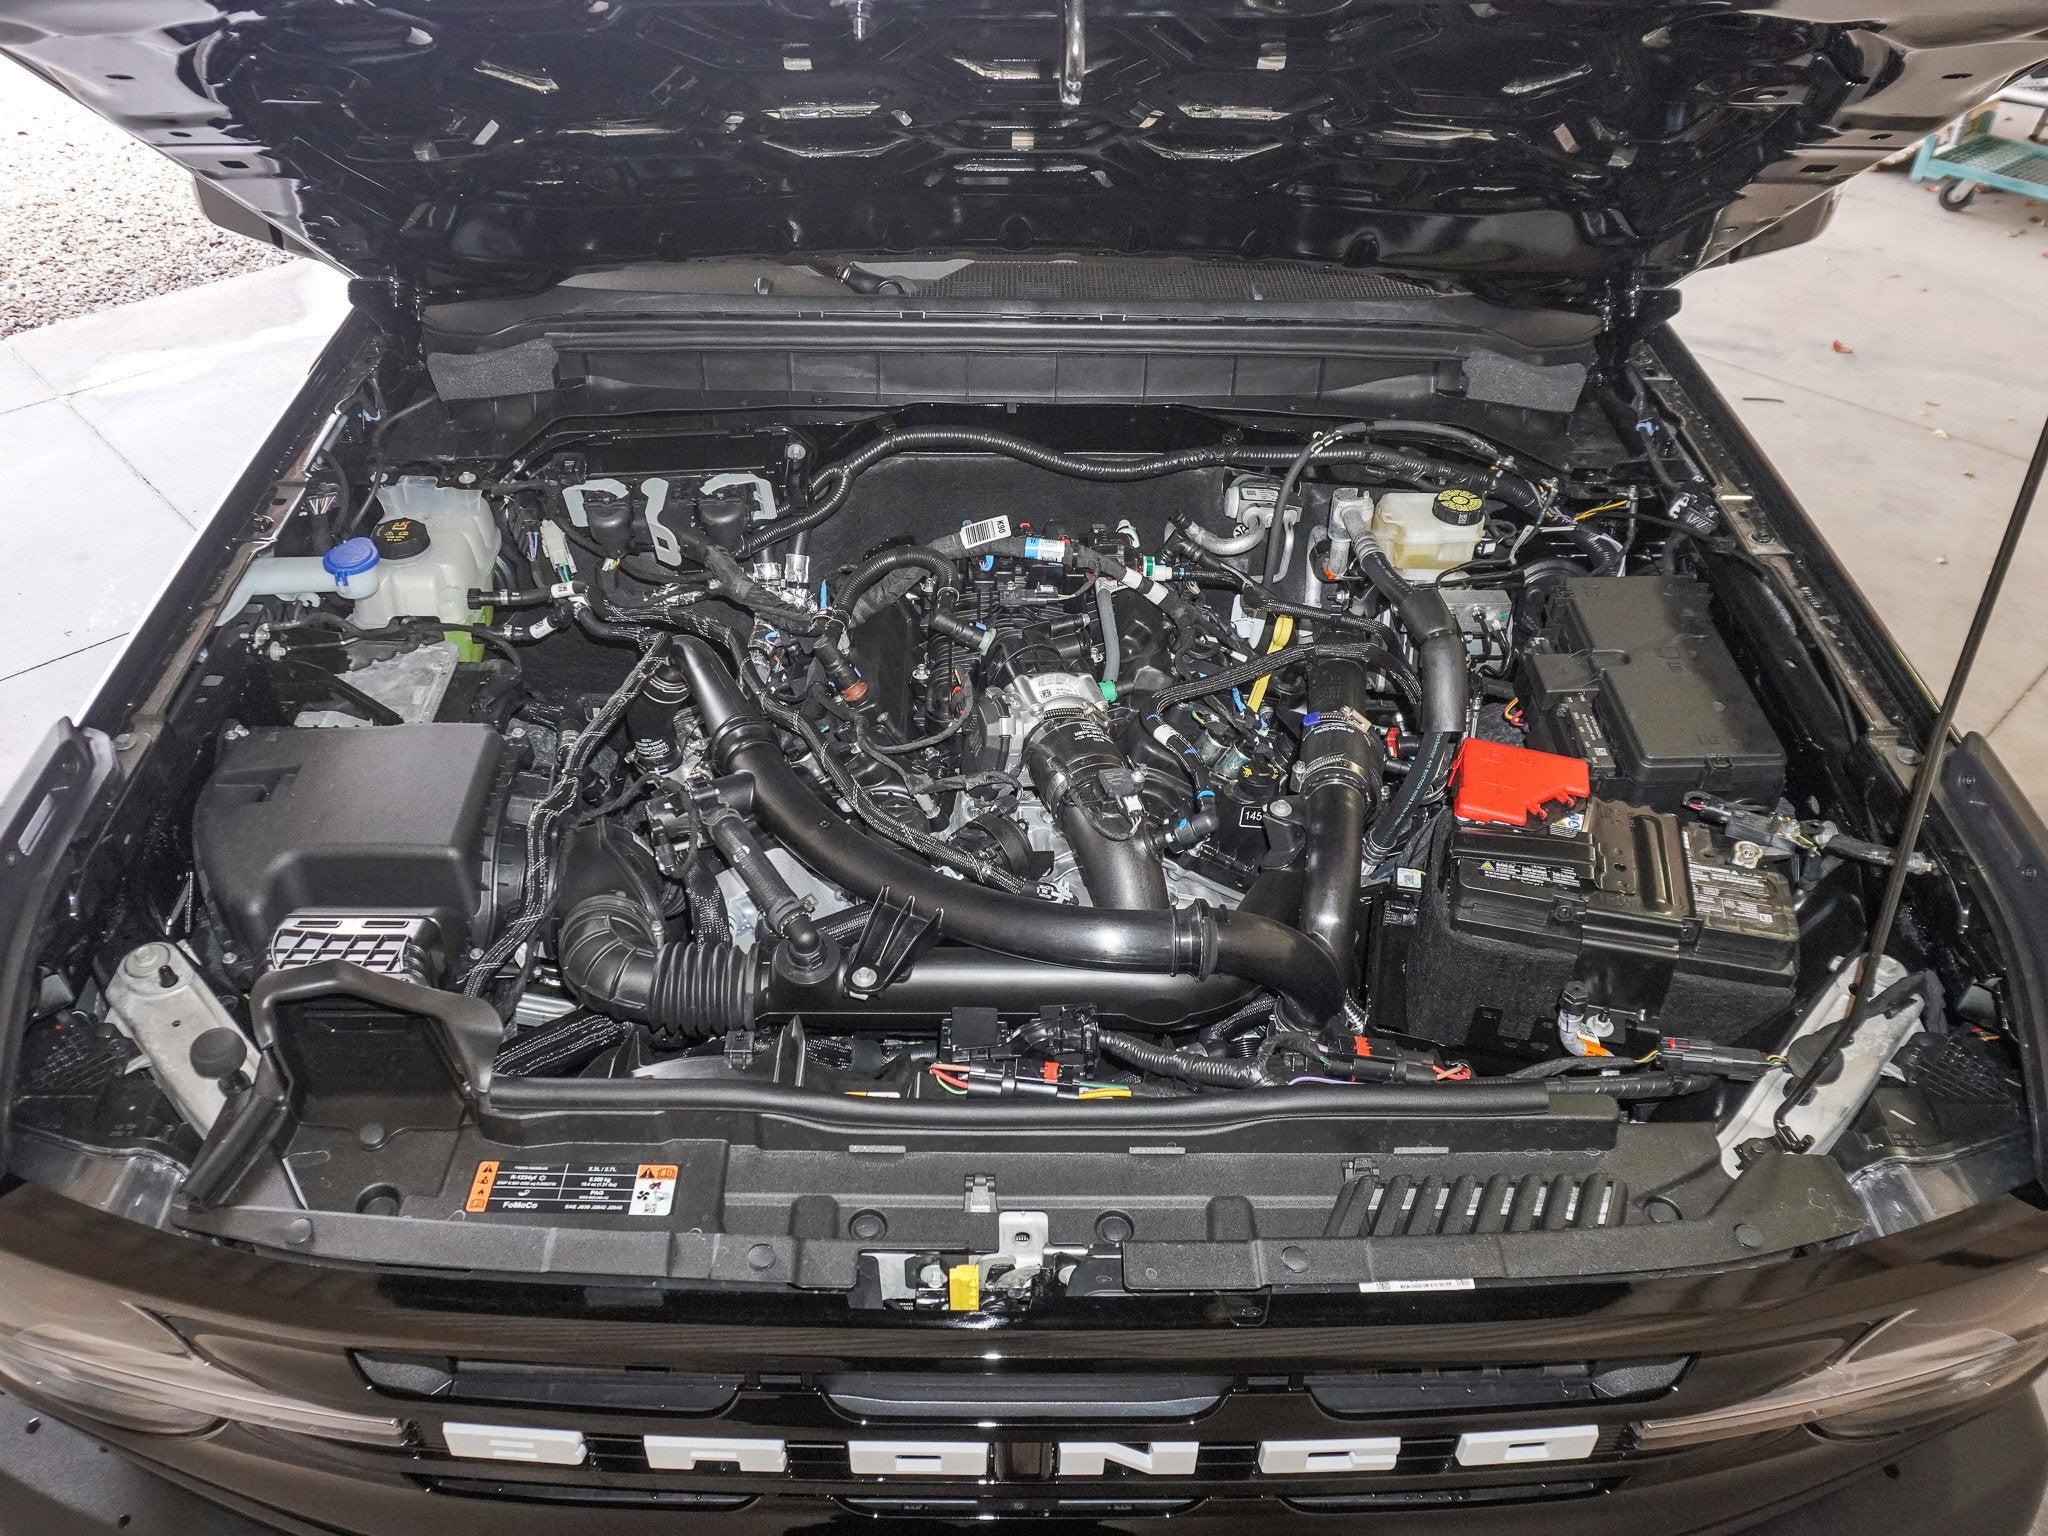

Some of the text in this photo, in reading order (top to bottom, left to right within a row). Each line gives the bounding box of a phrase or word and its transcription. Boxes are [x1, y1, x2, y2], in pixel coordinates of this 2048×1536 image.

[1245, 811, 1263, 821] 145
[502, 1201, 539, 1209] FoMoCo
[442, 1421, 1600, 1476] BRONCO
